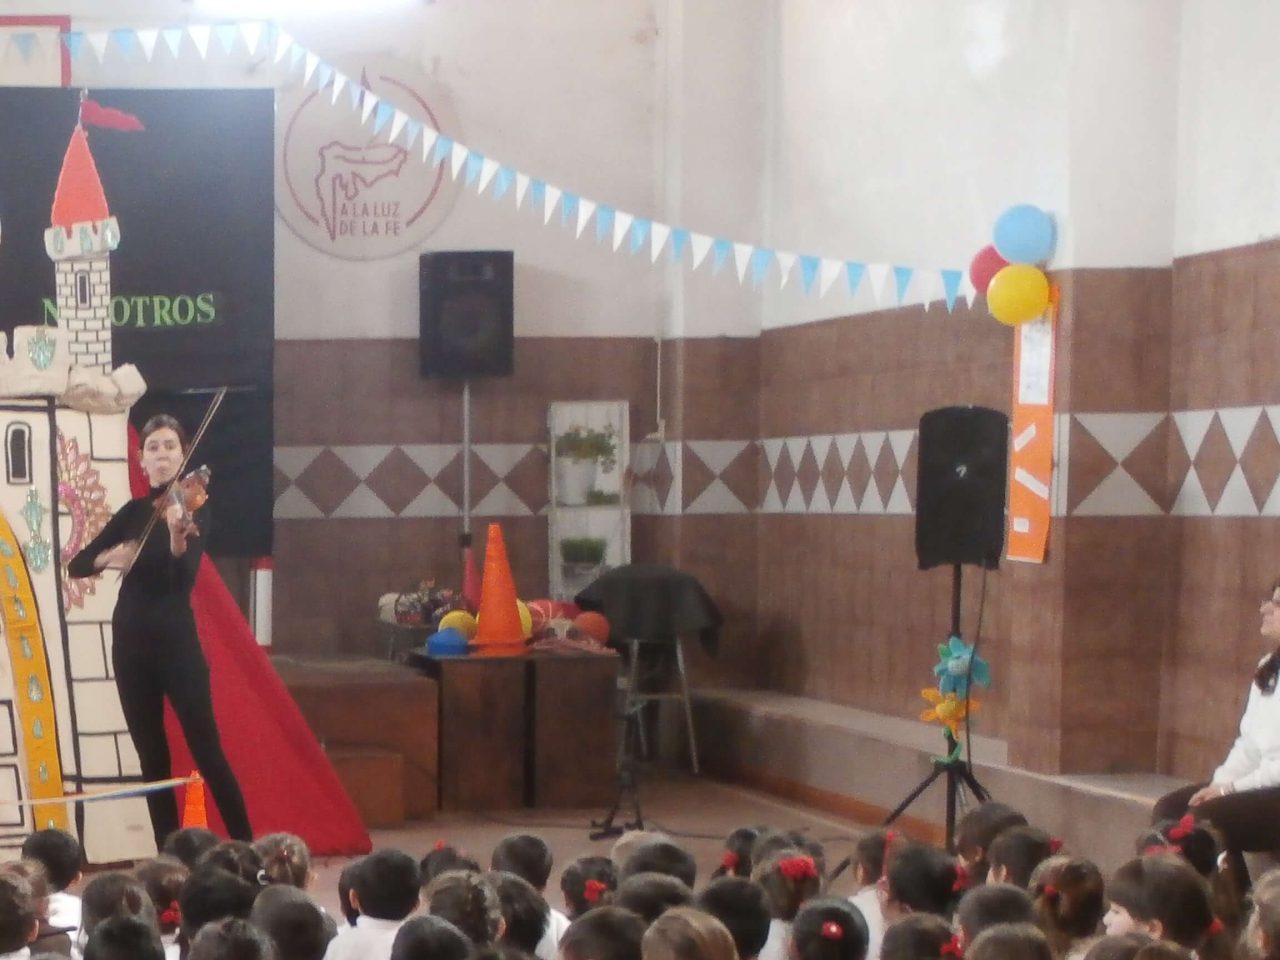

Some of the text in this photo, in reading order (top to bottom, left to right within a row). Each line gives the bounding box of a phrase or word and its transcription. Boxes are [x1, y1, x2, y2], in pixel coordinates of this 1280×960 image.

[340, 202, 401, 218] A LA LUZ
[339, 221, 401, 236] DE LA FE
[42, 293, 216, 328] NOTROS
